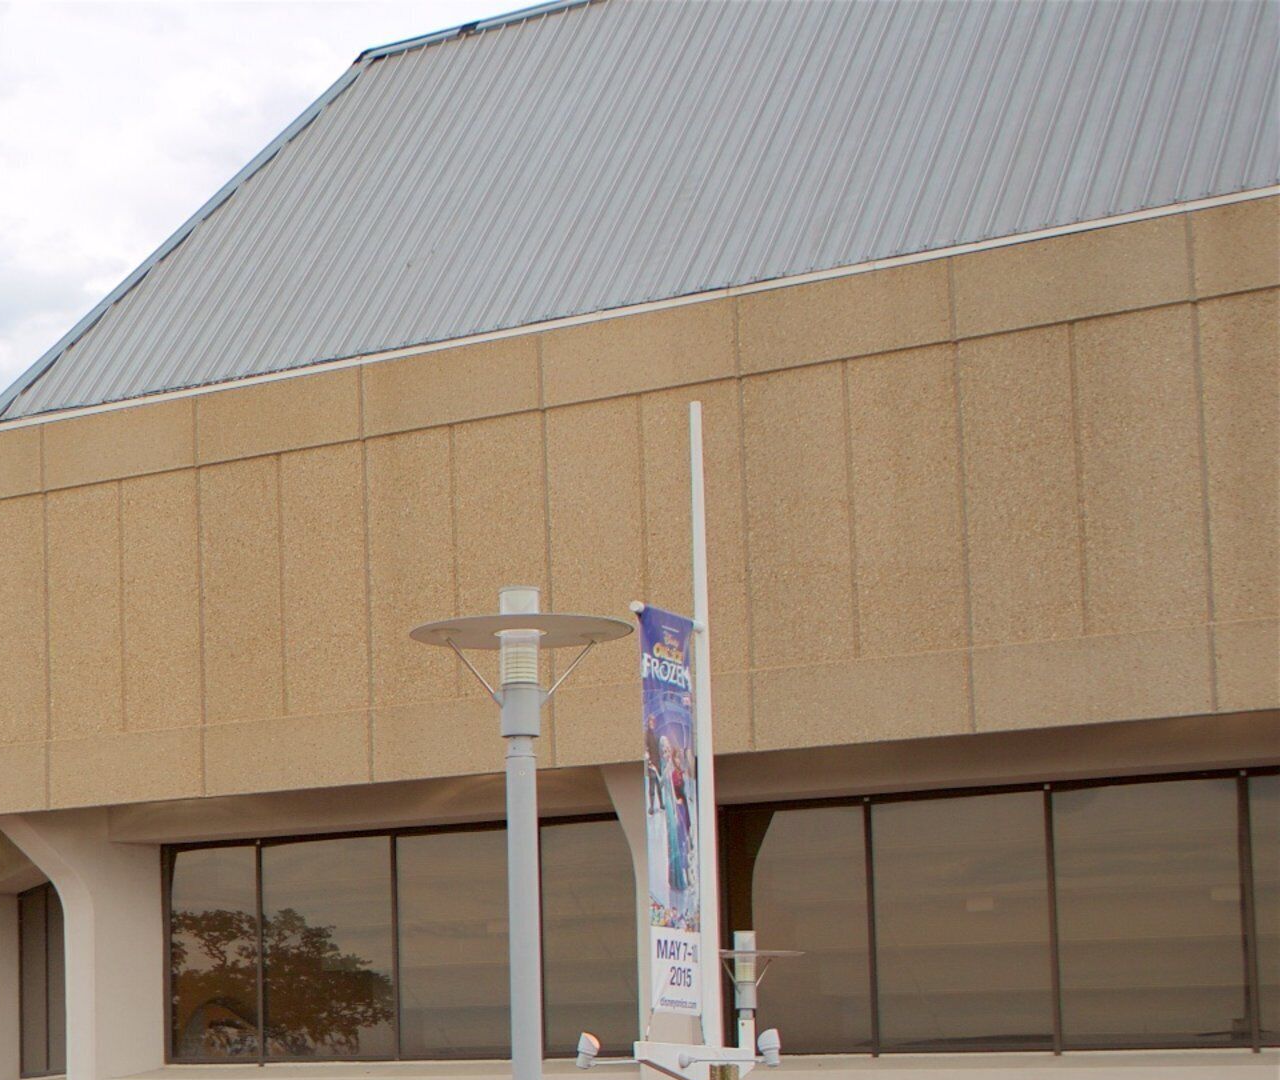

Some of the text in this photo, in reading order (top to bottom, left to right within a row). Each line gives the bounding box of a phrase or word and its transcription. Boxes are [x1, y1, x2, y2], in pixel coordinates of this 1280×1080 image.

[642, 652, 691, 691] FROZEN
[657, 939, 681, 960] MAY
[669, 966, 692, 988] 2015
